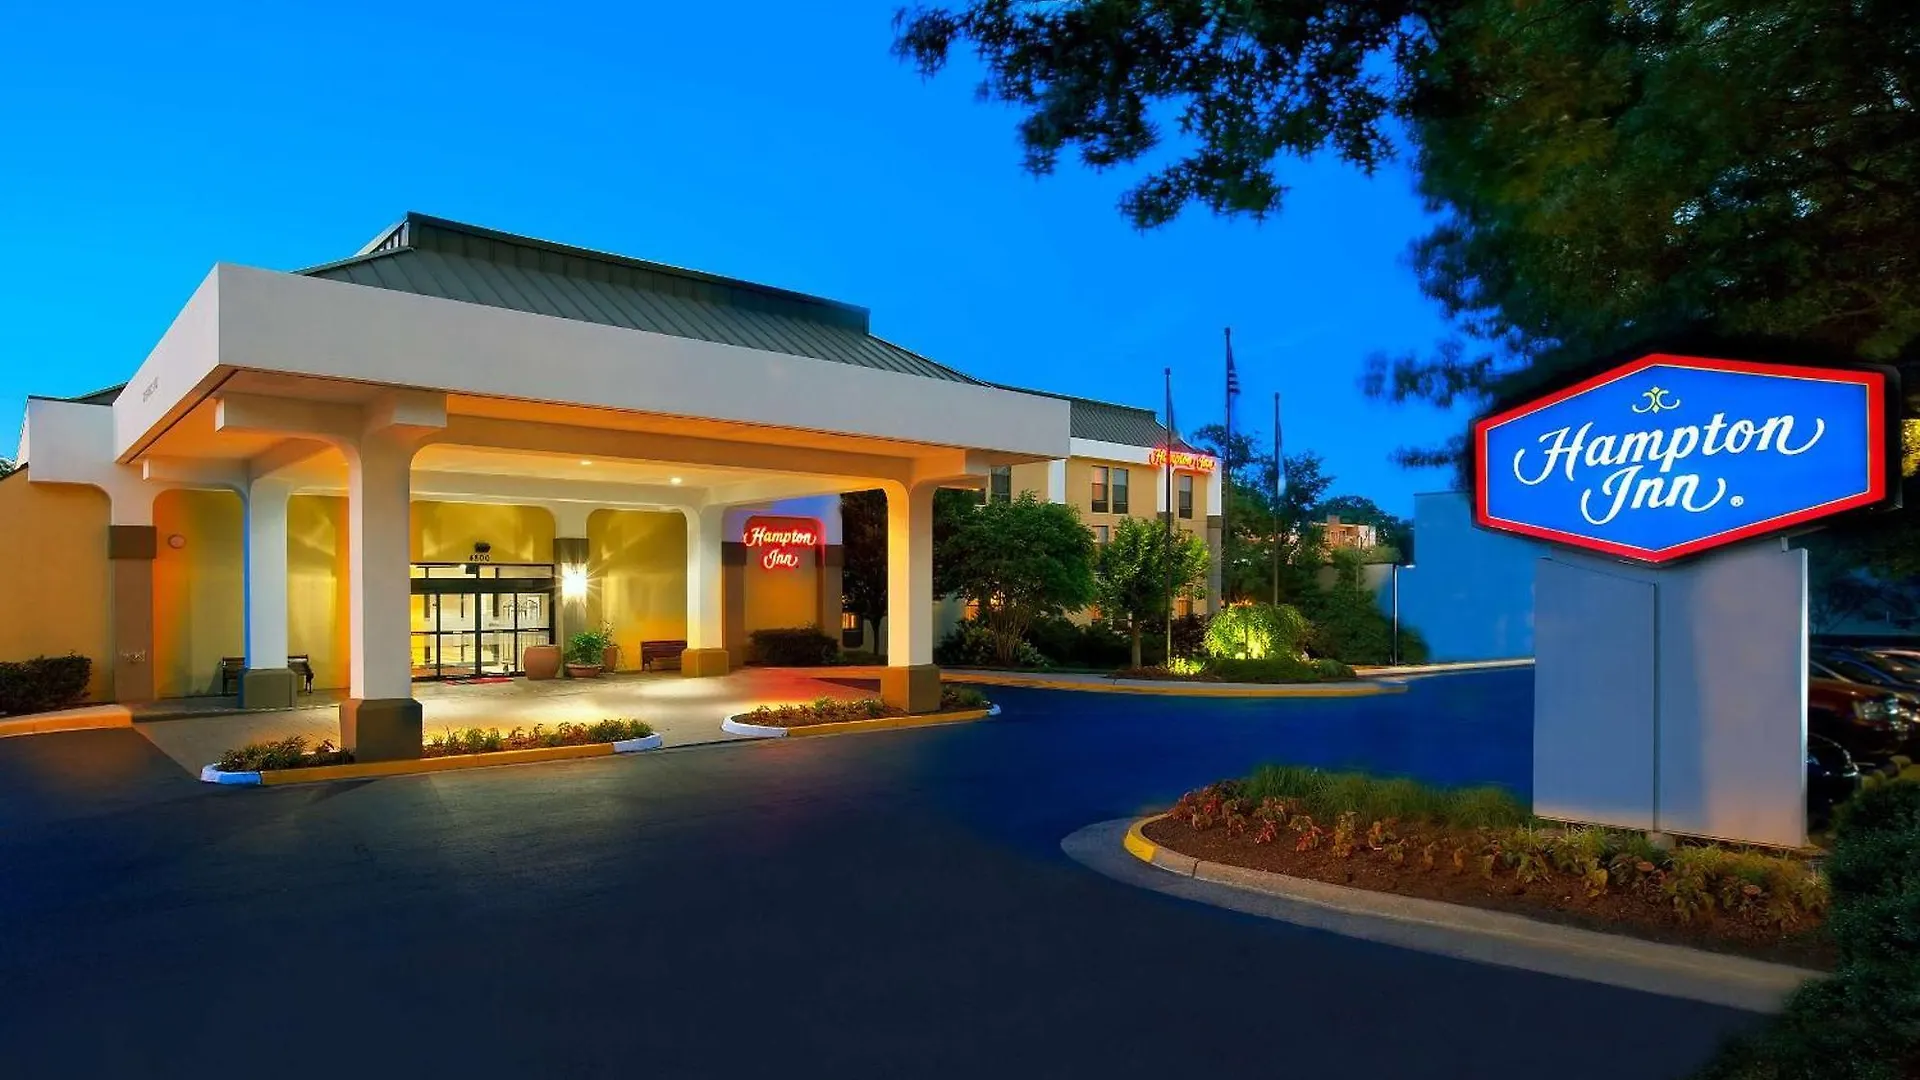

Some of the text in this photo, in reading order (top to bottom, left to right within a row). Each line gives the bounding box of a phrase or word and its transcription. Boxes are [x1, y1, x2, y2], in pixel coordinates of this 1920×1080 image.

[1513, 413, 1825, 485] Hampton
[1581, 465, 1726, 525] Inn
[743, 526, 817, 547] Hampton
[764, 549, 798, 569] Inn
